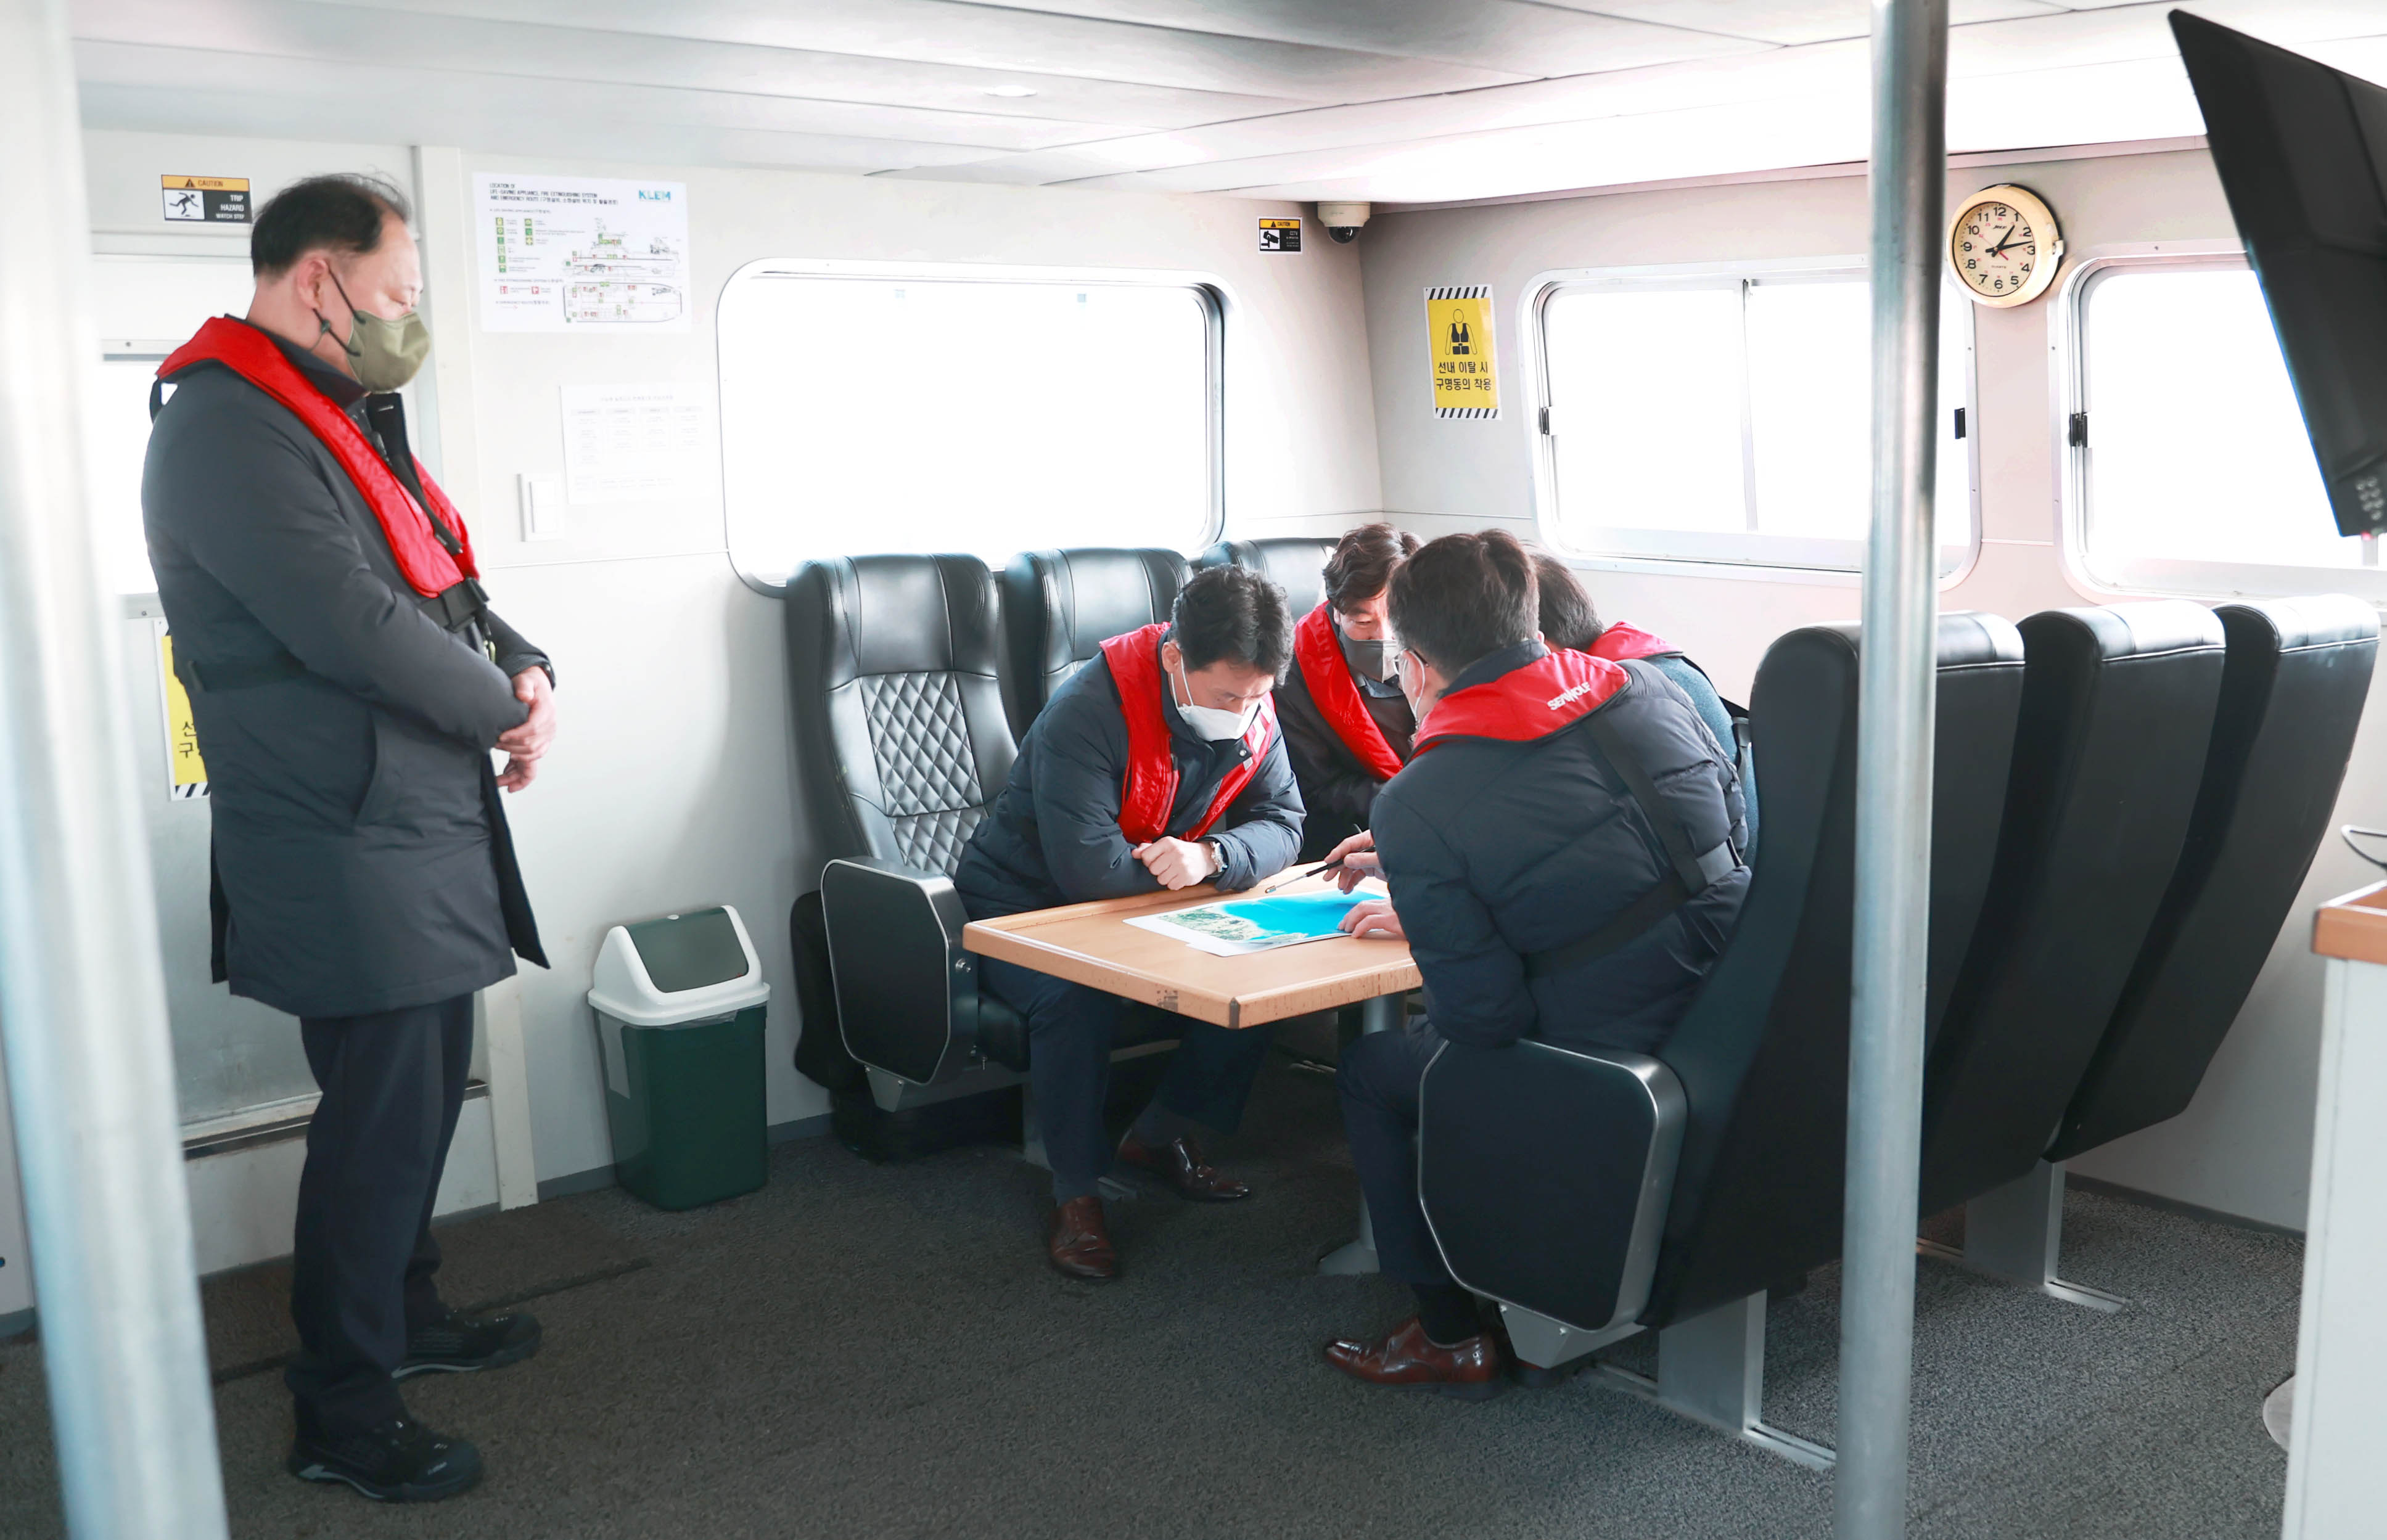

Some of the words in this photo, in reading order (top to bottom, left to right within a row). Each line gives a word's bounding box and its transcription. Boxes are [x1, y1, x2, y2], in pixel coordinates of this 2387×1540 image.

[639, 190, 671, 200] KLEM
[220, 204, 244, 212] HAZARD
[1993, 207, 2007, 216] 12
[1978, 213, 1989, 221] 11
[2014, 212, 2019, 222] 1
[1968, 225, 1979, 235] 10
[2023, 227, 2031, 237] 2
[1963, 241, 1972, 252] 9
[2027, 245, 2035, 255] 3
[1967, 258, 1976, 269] 8
[2021, 263, 2030, 272] 4
[1979, 274, 1988, 284] 7
[1994, 279, 2003, 289] 6
[2010, 276, 2019, 285] 5
[1438, 361, 1455, 374] 선내
[1458, 361, 1476, 374] 이탈
[1480, 361, 1488, 374] 시
[1436, 378, 1471, 390] 구명동의
[1474, 378, 1492, 391] 착용
[1547, 682, 1591, 710] SEAWOLF
